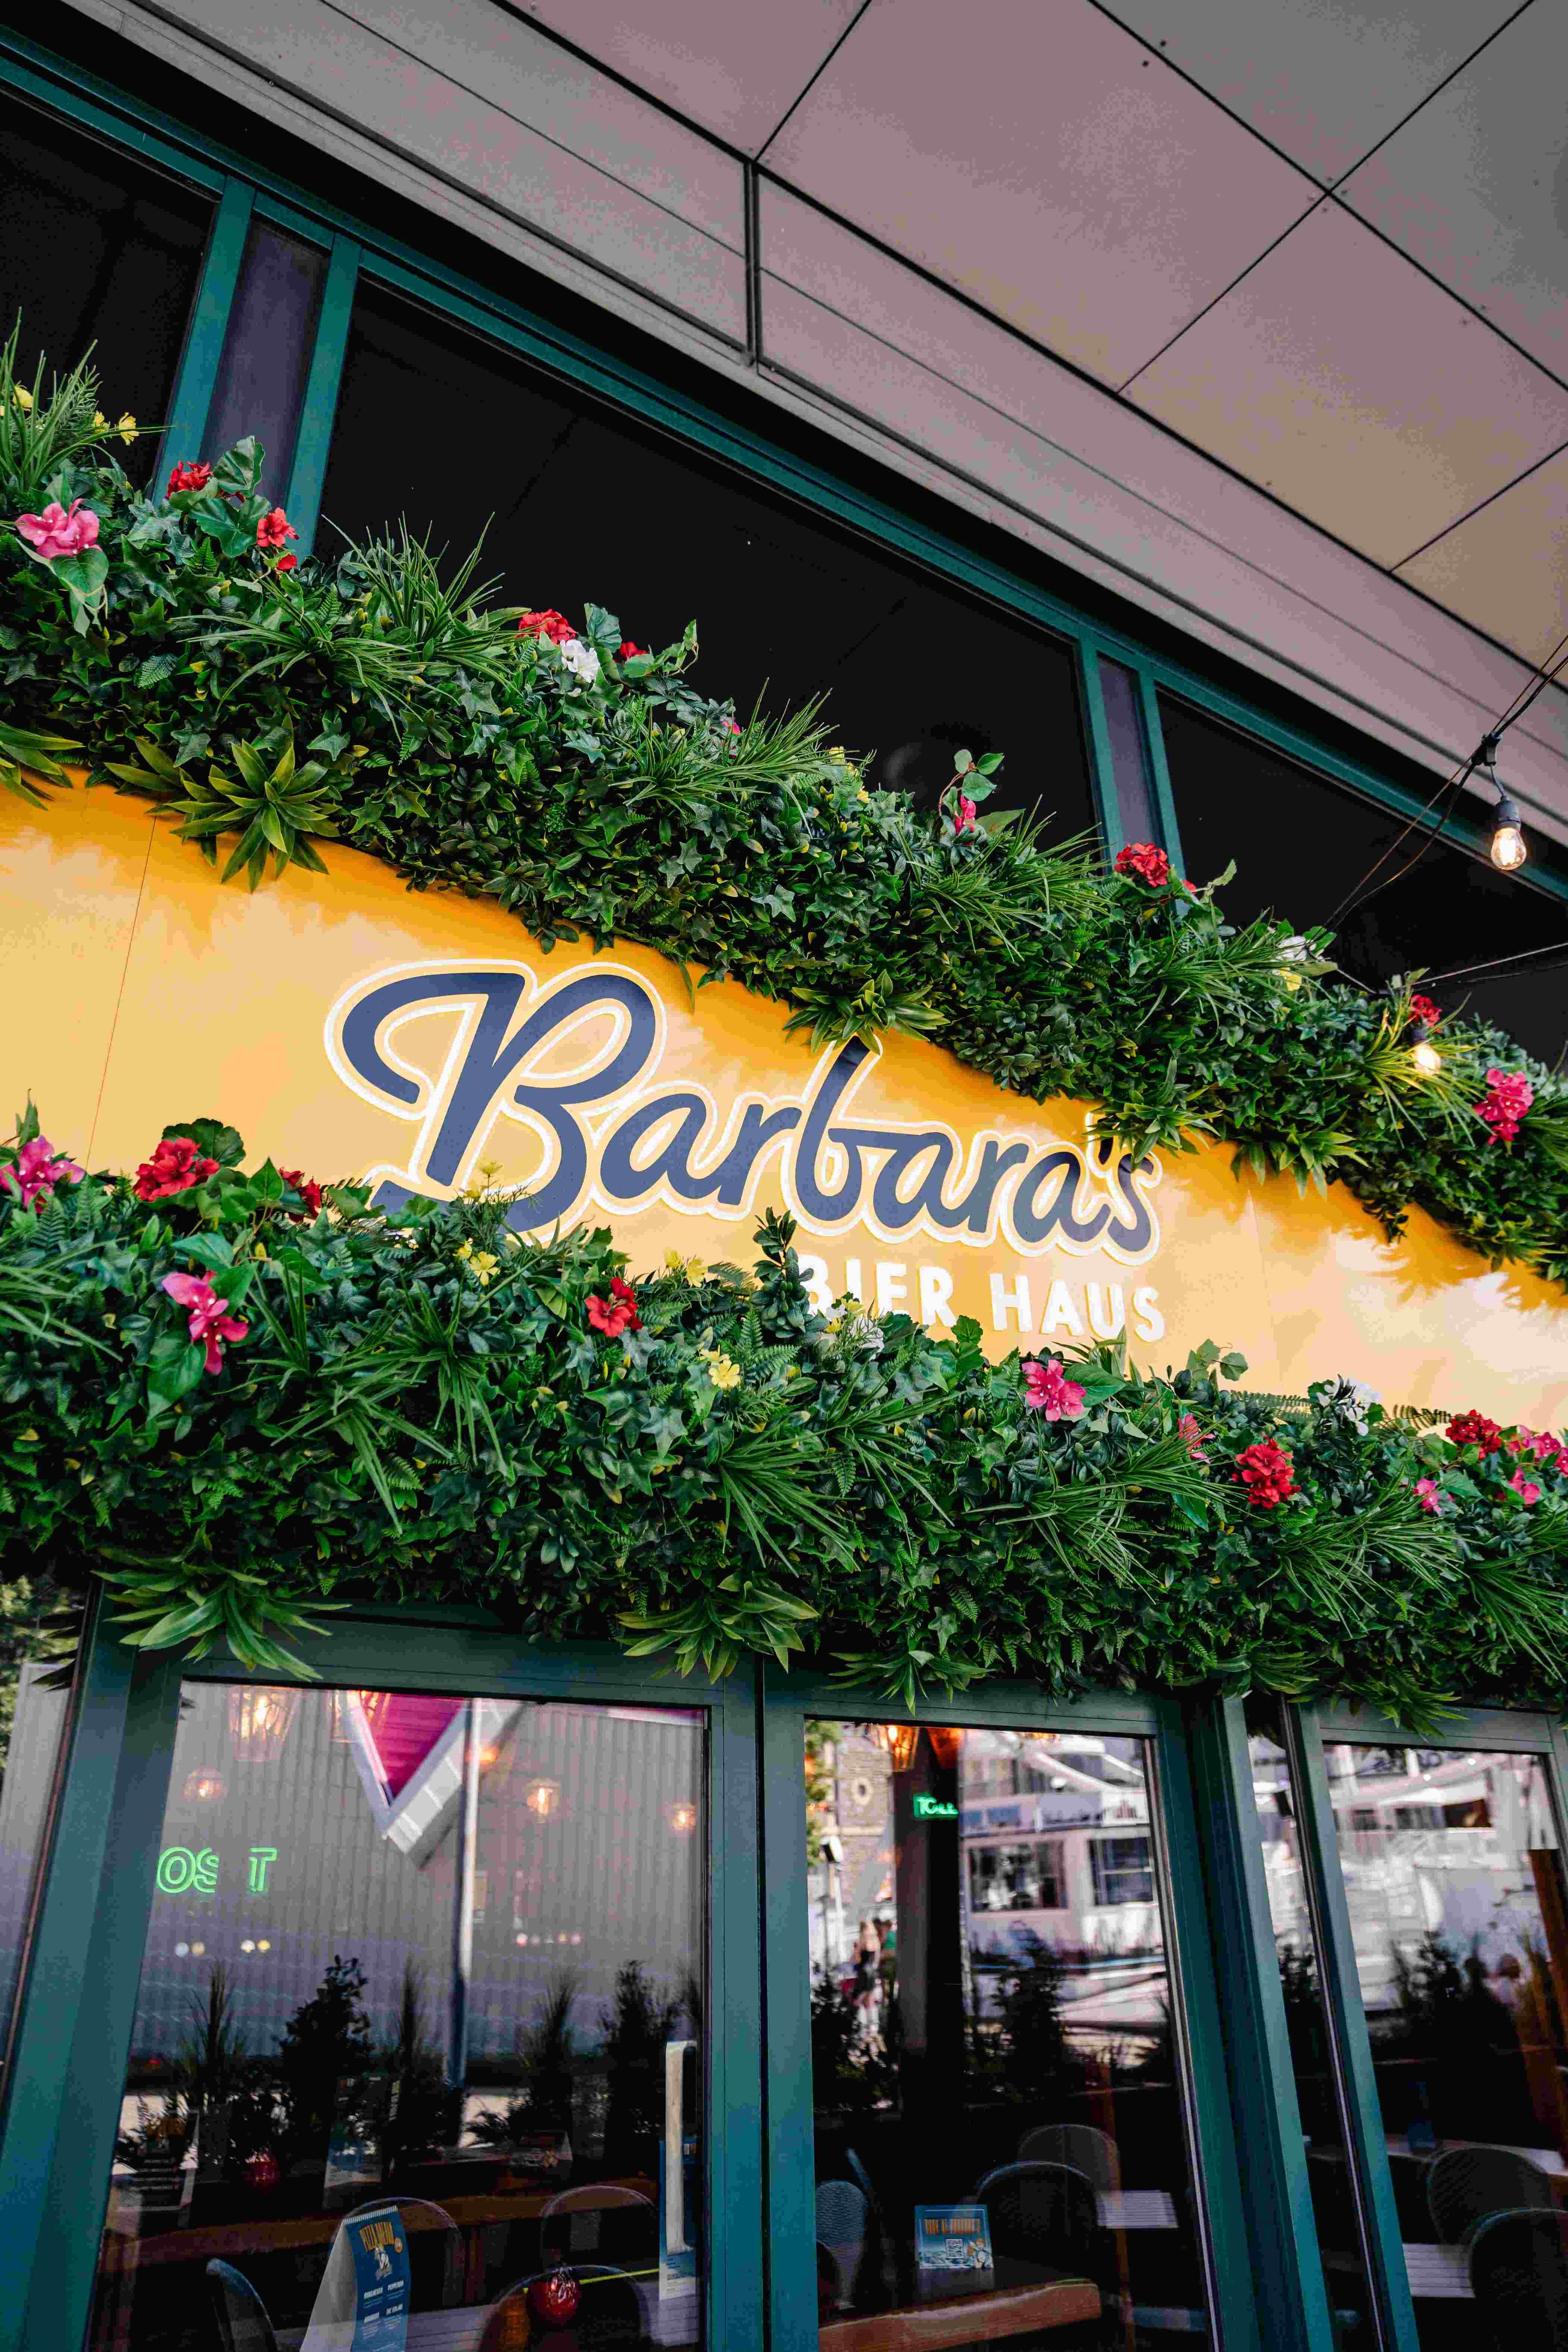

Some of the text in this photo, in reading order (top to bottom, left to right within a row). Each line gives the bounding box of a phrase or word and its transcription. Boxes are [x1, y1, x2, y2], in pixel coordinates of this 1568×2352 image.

[325, 960, 1163, 1264] Barbara's
[798, 1254, 1165, 1343] BIER HAUS
